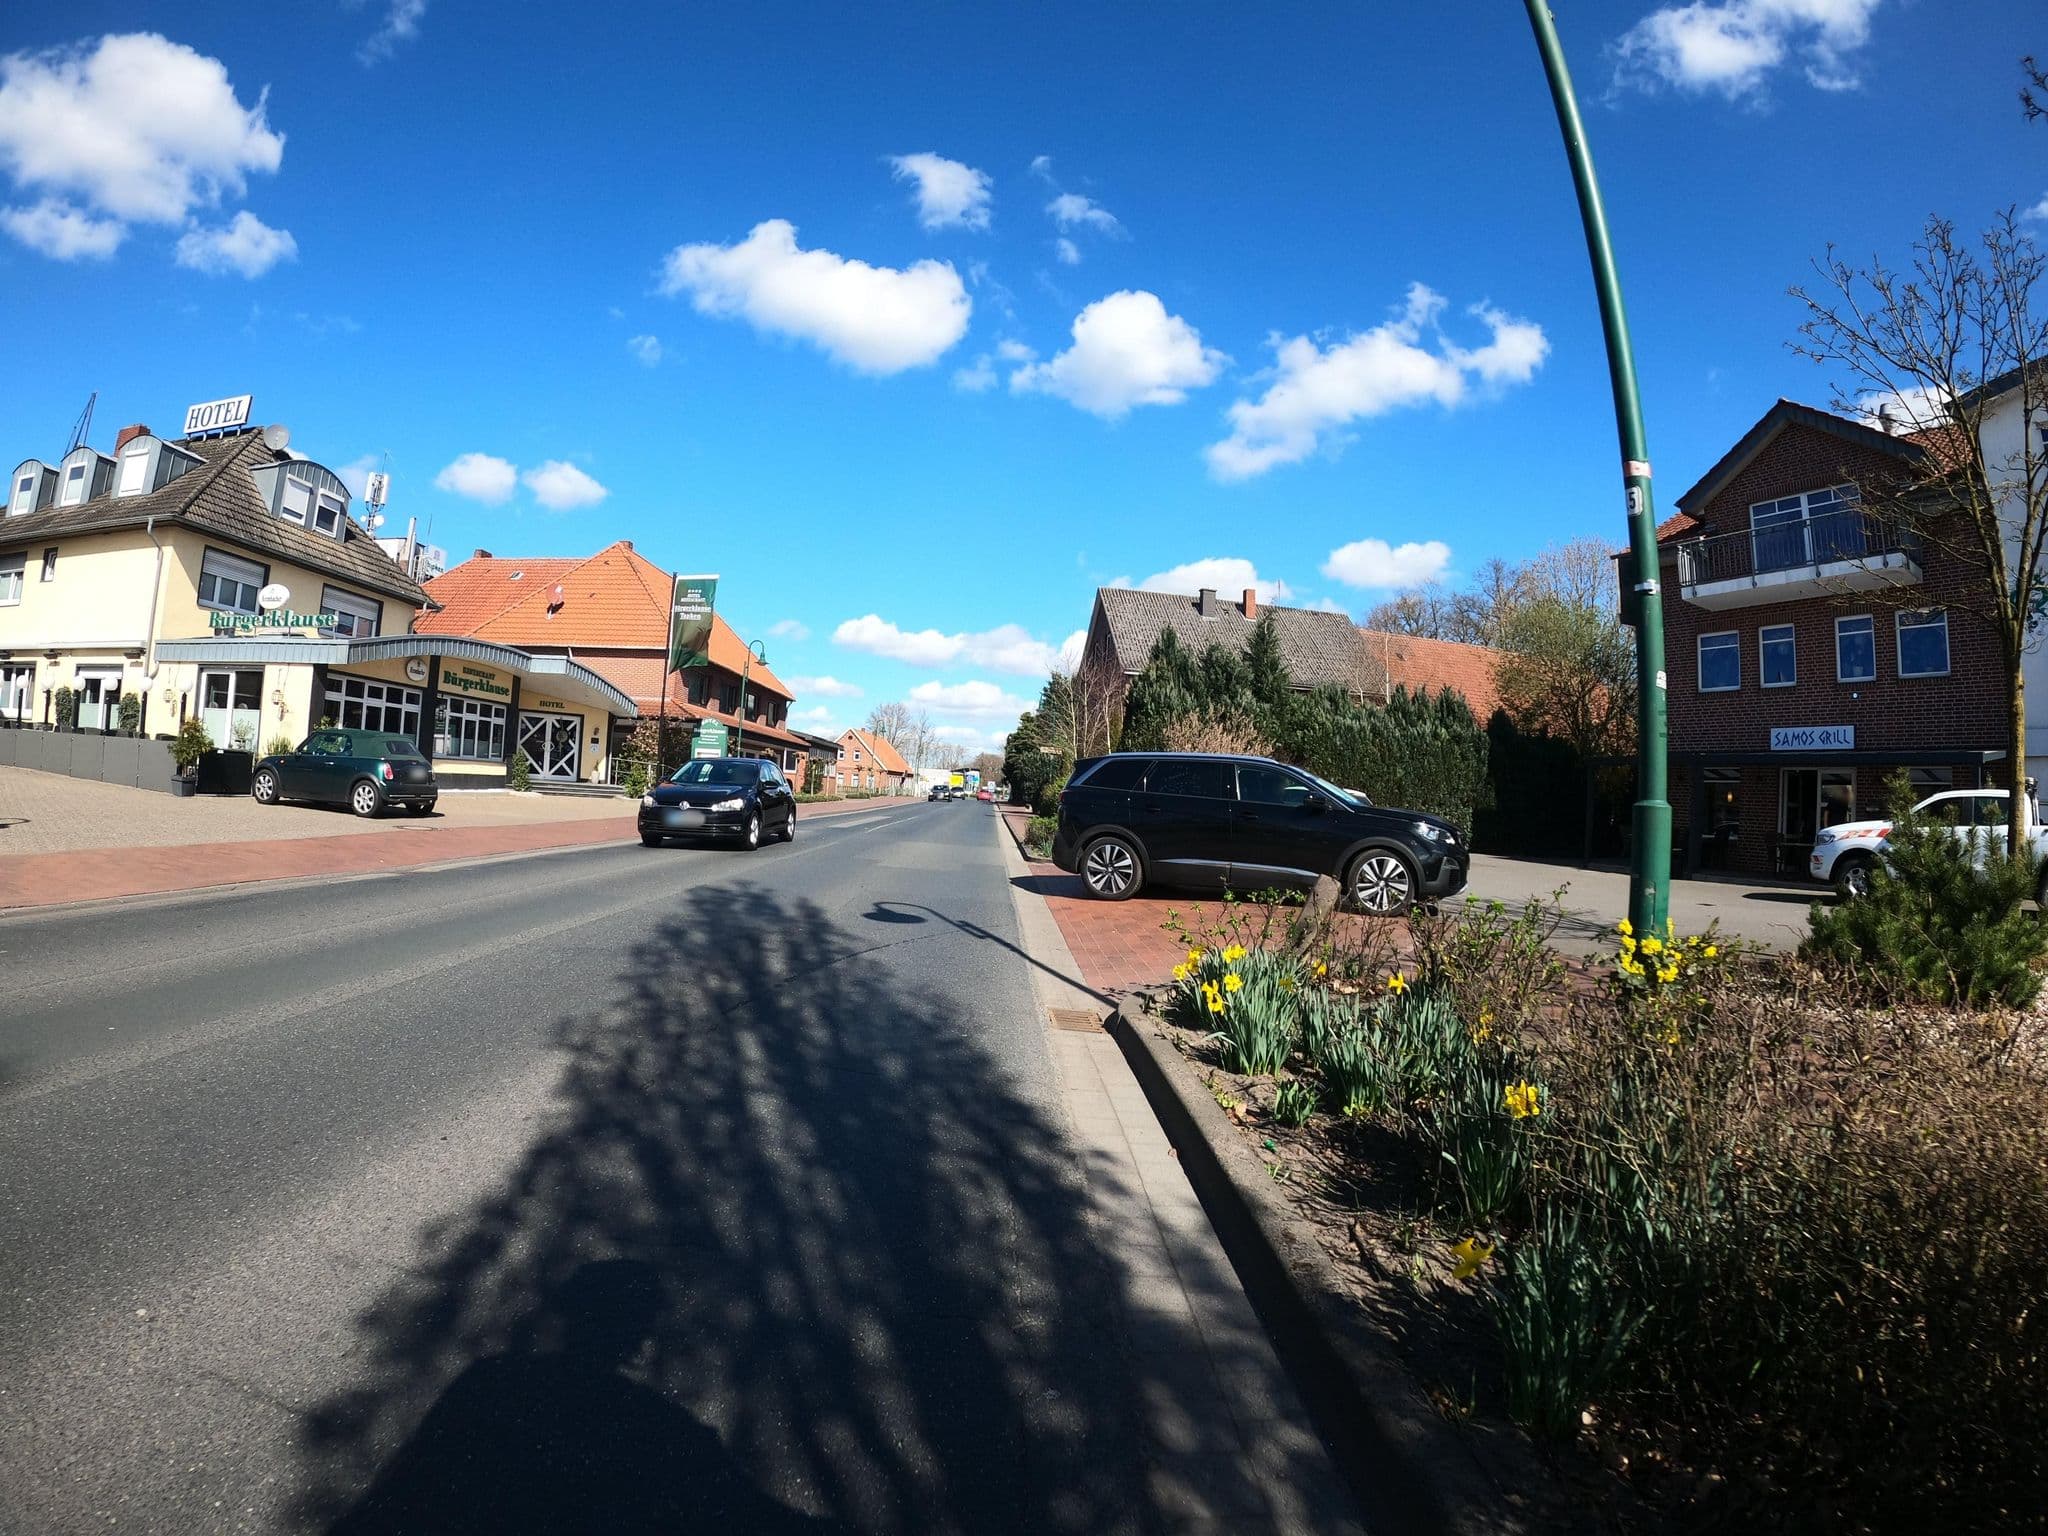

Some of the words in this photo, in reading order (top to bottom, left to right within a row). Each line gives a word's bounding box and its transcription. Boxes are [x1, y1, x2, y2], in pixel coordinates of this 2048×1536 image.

[187, 399, 243, 430] HOTEL
[208, 608, 336, 632] Bürgerklause
[443, 670, 510, 697] Bürgerklause
[539, 700, 566, 709] HOTEL
[1774, 730, 1816, 747] SAMOS
[1818, 728, 1851, 745] GRILL
